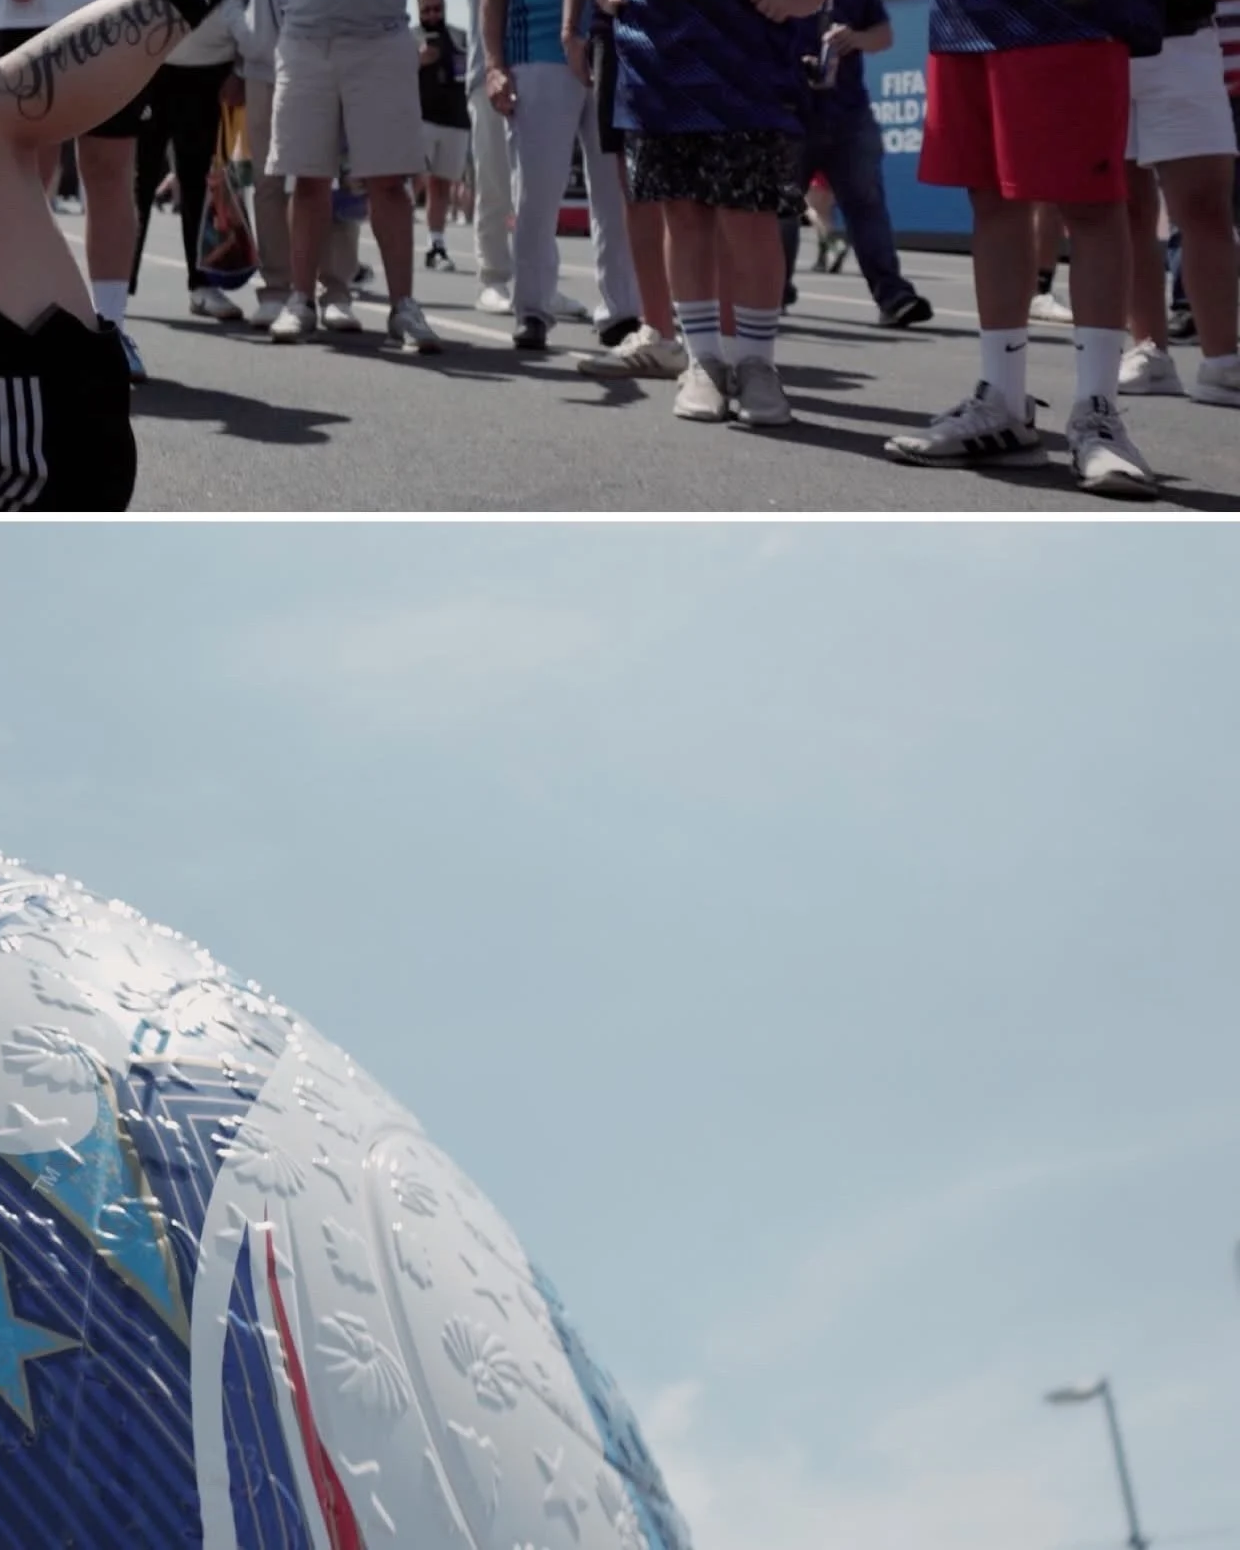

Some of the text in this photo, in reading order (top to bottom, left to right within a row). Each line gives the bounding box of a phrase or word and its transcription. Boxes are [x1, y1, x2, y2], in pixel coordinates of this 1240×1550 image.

[881, 70, 927, 98] FIFA
[870, 99, 920, 124] ORLD
[881, 127, 924, 153] 02
[31, 1165, 61, 1191] TM
